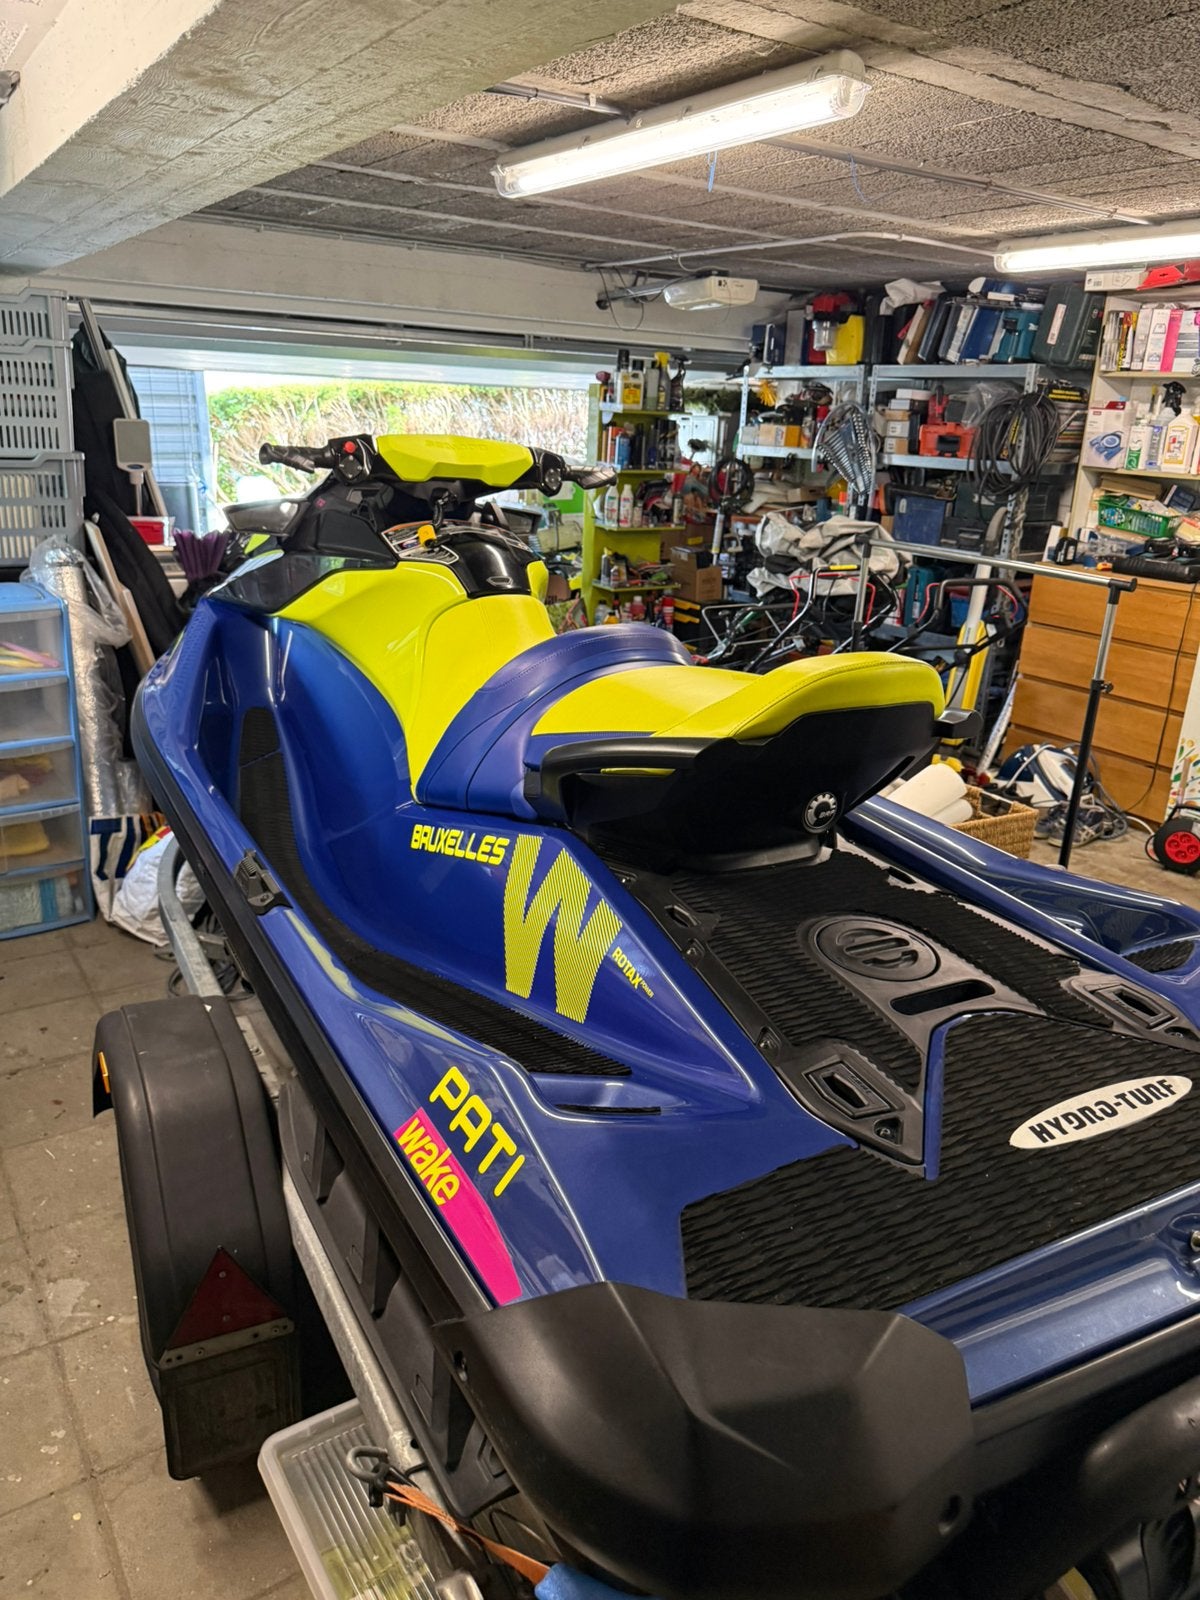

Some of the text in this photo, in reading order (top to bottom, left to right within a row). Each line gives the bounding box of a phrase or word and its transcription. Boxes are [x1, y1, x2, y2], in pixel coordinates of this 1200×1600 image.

[410, 824, 510, 866] BRUXELLES
[612, 946, 643, 990] ROTAX
[429, 1066, 525, 1197] PATI
[1028, 1079, 1177, 1144] HYDRO-TURF
[397, 1117, 462, 1206] wake
